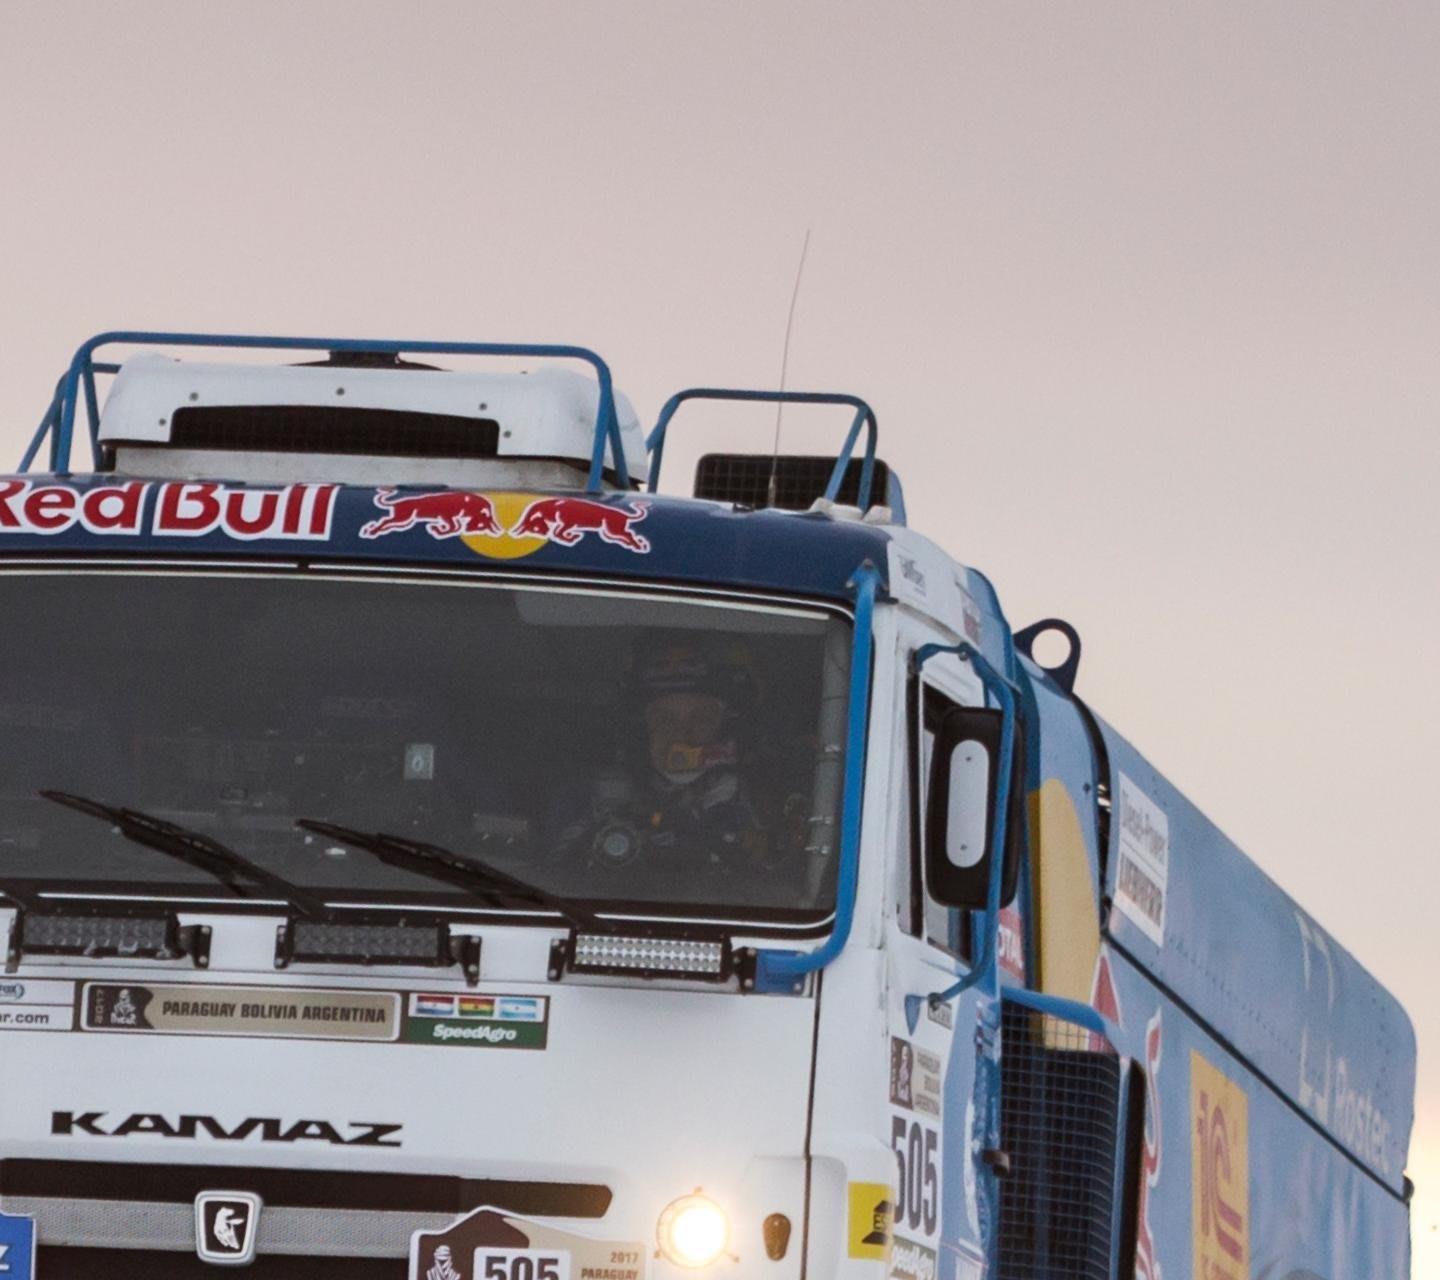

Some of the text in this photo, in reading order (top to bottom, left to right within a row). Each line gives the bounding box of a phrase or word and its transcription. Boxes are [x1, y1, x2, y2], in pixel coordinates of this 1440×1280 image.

[154, 481, 339, 541] Bull
[162, 1001, 386, 1023] PARAGUAY BOLIVIA ARGENTINA
[432, 1023, 518, 1042] SpeedAgro
[51, 1111, 404, 1147] KAMAZ
[892, 1115, 938, 1237] 505
[610, 1252, 639, 1263] 2017
[580, 1268, 638, 1280] PARAGUAY
